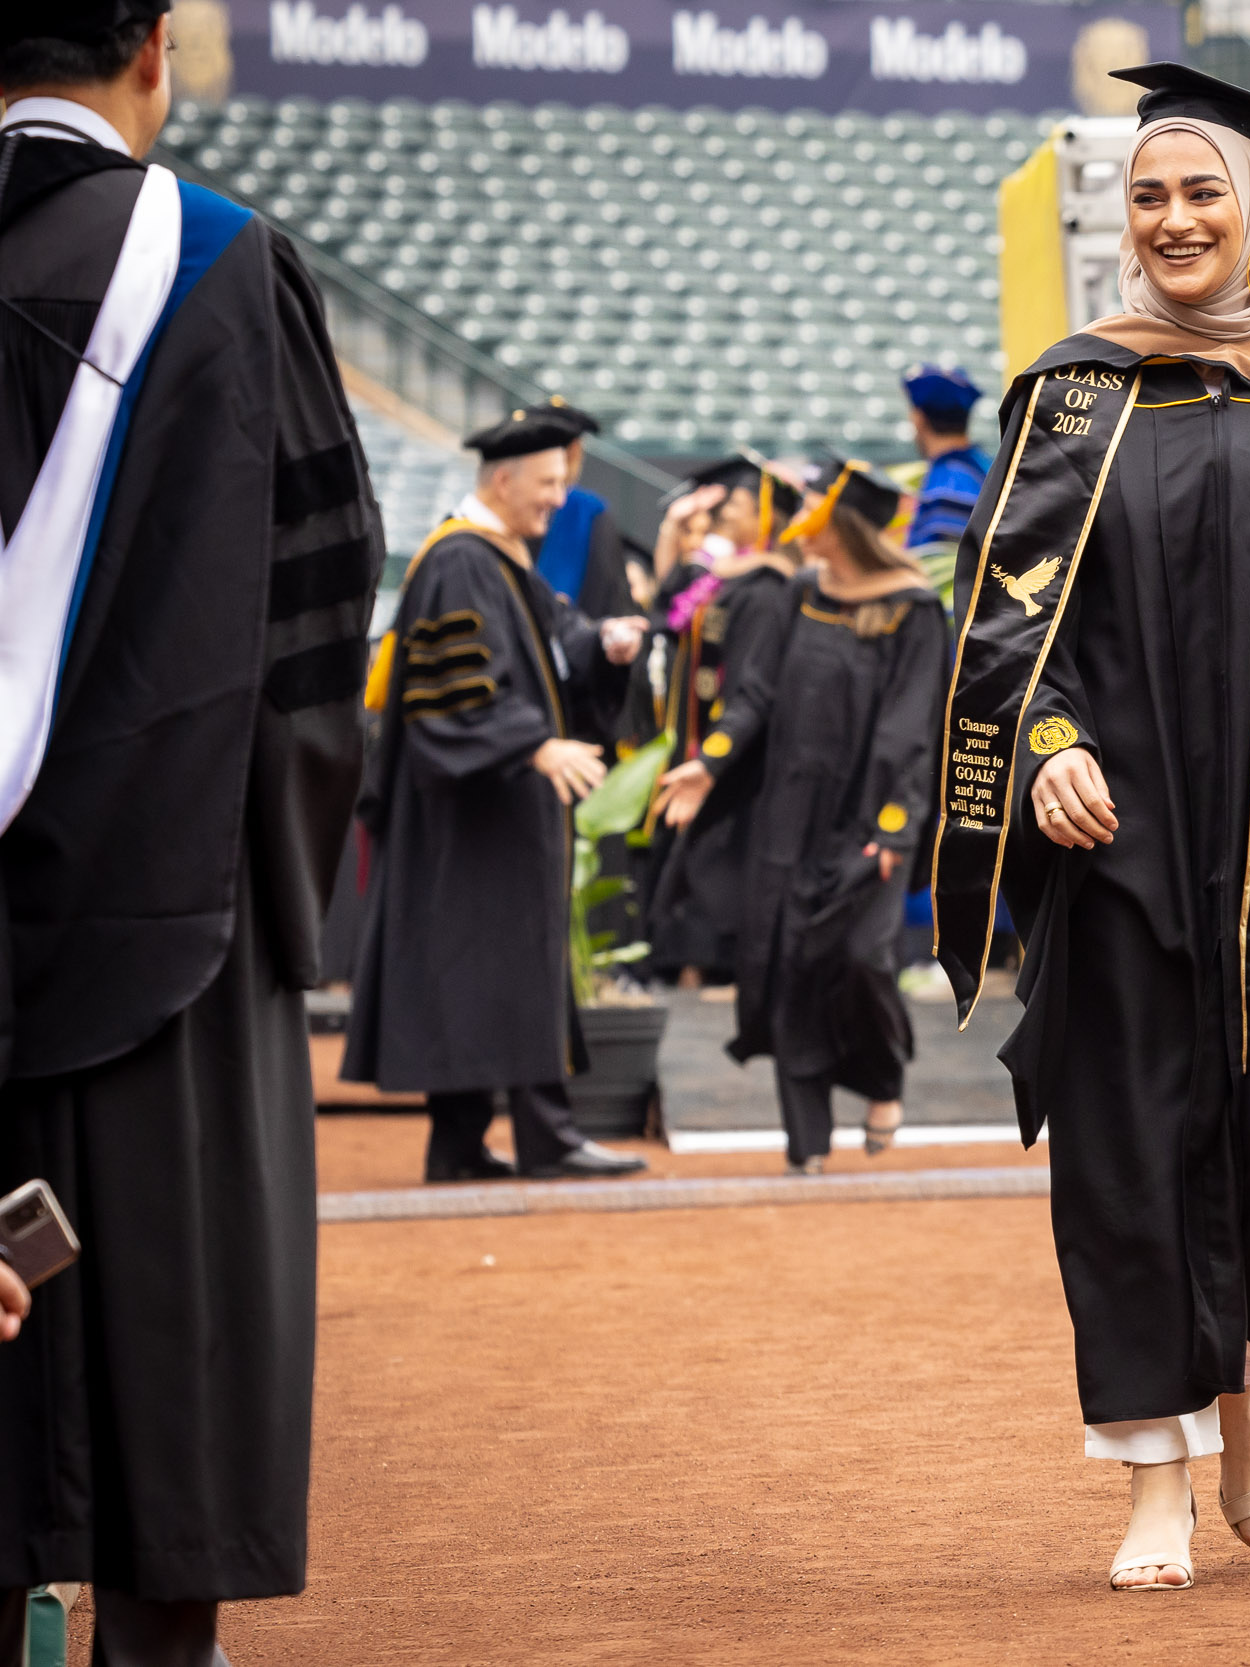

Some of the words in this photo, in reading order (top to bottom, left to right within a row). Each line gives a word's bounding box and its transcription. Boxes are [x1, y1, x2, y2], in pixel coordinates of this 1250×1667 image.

[270, 0, 429, 67] Modelo
[472, 3, 629, 73] Modelo
[672, 10, 828, 79] Modelo
[870, 15, 1026, 83] Modelo
[1054, 364, 1126, 391] CLASS
[1065, 388, 1098, 411] OF
[1052, 412, 1093, 435] 2021
[959, 718, 999, 736] Change
[965, 737, 991, 750] your
[952, 749, 990, 766] dreams
[992, 755, 1004, 769] to
[956, 766, 997, 783] GOALS
[954, 784, 974, 797] and
[975, 787, 992, 801] you
[949, 799, 968, 812] will
[969, 803, 985, 816] get
[986, 803, 996, 818] to
[960, 815, 984, 831] them
